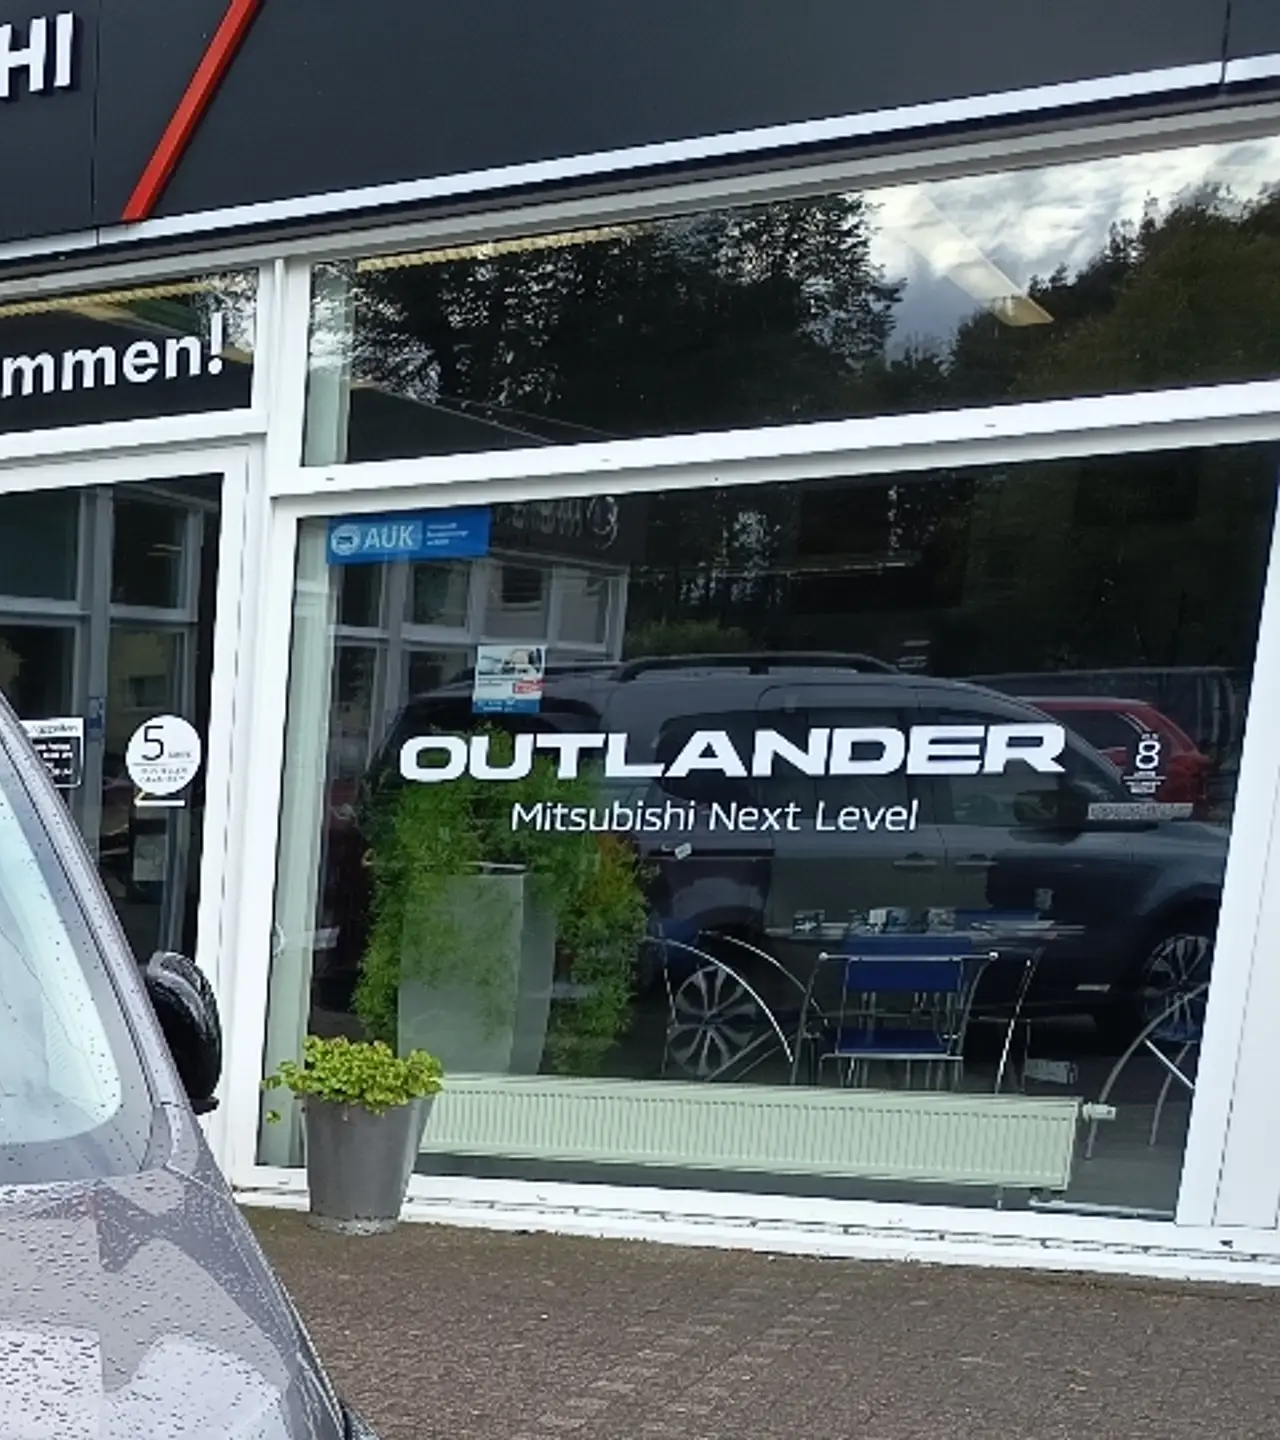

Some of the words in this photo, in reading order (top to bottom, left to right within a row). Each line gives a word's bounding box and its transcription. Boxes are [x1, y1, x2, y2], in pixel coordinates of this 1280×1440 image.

[363, 524, 414, 549] AUK
[140, 726, 164, 761] 5
[398, 723, 1066, 782] OUTLANDER
[1135, 741, 1161, 769] 8
[511, 802, 695, 833] Mitsubishi
[709, 801, 800, 832] Next
[816, 800, 917, 832] Level
